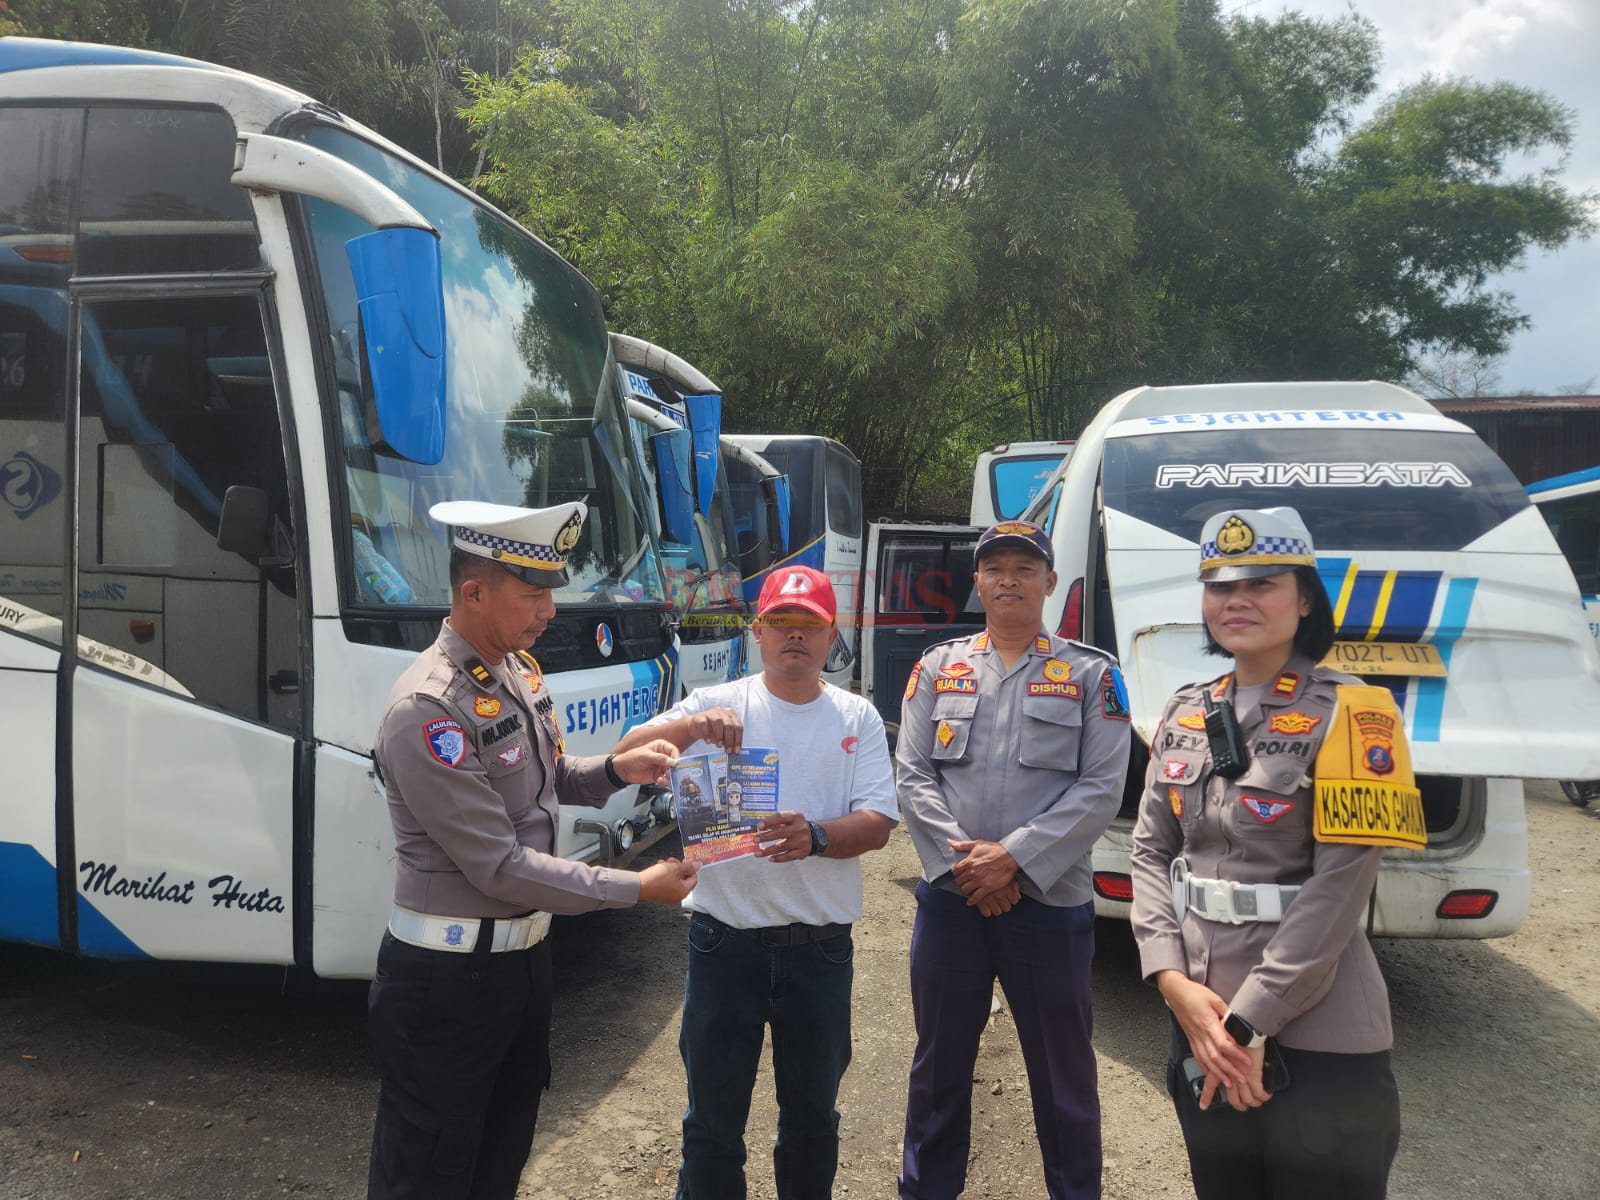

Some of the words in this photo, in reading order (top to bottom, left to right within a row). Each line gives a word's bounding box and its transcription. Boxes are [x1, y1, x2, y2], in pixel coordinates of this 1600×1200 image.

[1146, 411, 1405, 426] SEJAHTERA
[1156, 463, 1472, 488] PARIWISATA
[1332, 644, 1385, 662] 7027
[1401, 645, 1430, 663] UT
[1030, 683, 1078, 696] DISHUB
[566, 683, 659, 735] SEJAHTERA
[1254, 740, 1312, 757] POLRI
[1321, 786, 1390, 832] KASATGAS
[79, 860, 195, 904] Marihat
[208, 875, 285, 913] Huta
